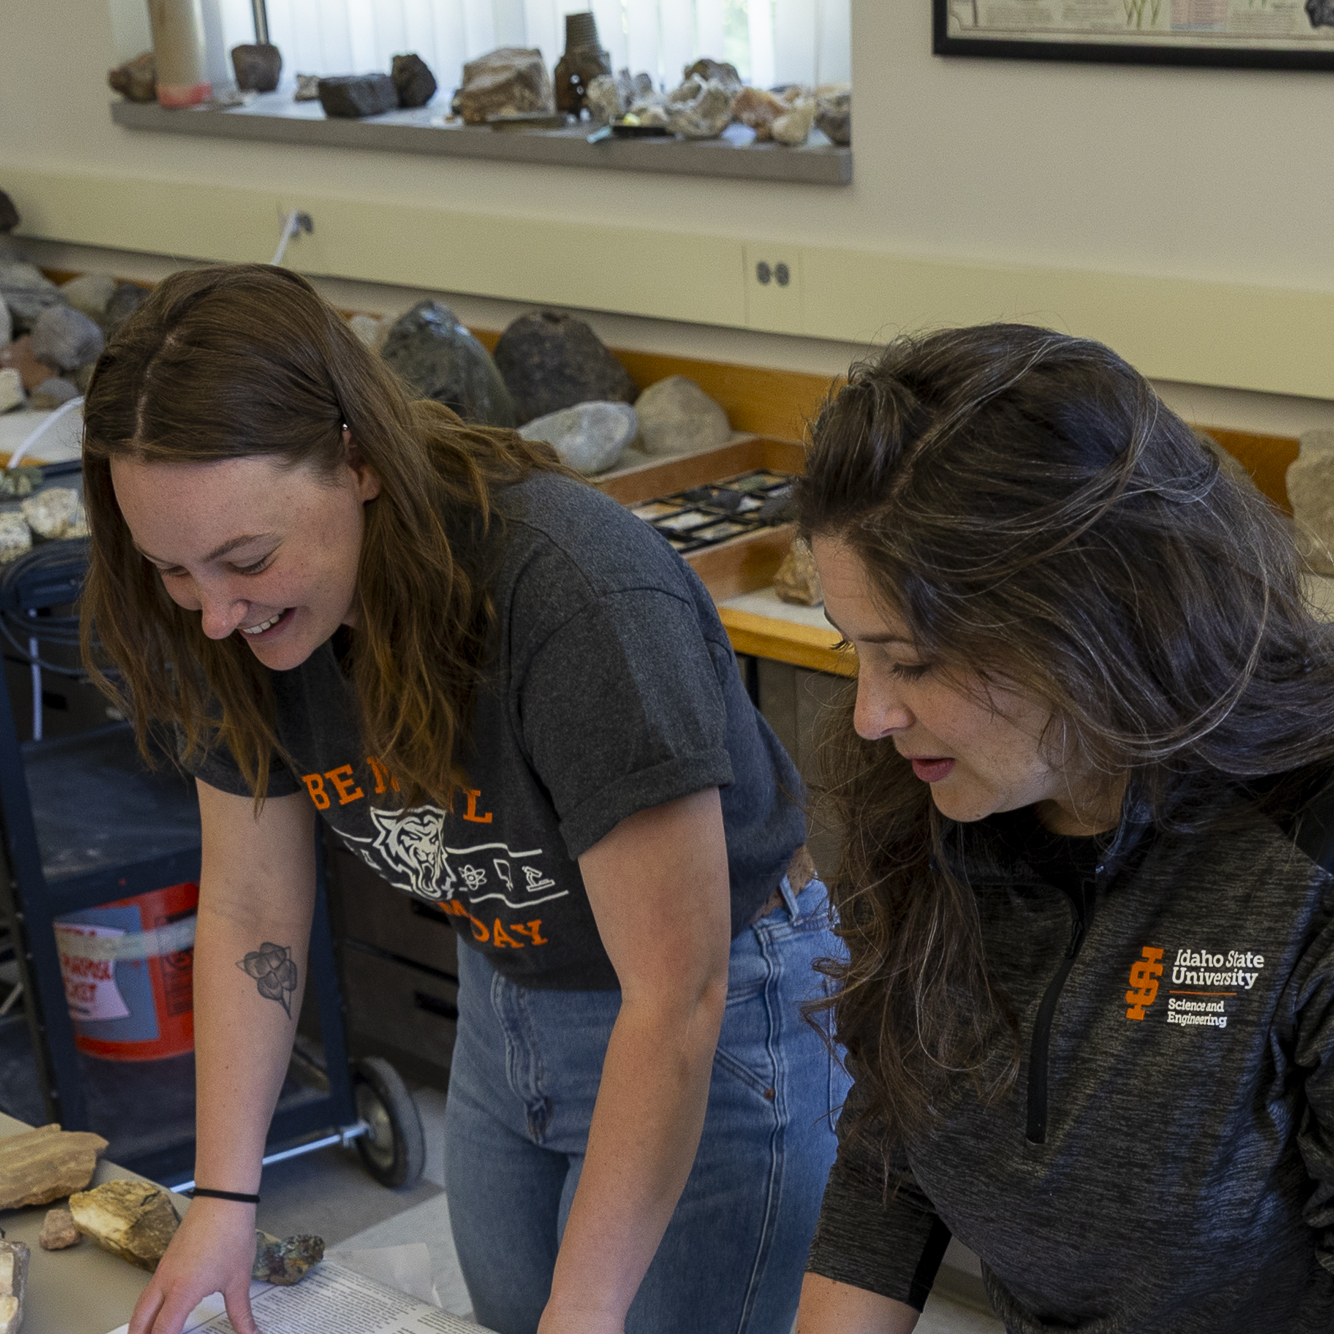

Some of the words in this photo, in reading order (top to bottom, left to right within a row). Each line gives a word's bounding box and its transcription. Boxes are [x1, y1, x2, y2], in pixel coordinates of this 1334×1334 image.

[1174, 949, 1224, 968] Idaho
[1225, 950, 1264, 968] State
[1171, 966, 1259, 989] University
[1168, 998, 1206, 1011] Science
[1206, 1001, 1224, 1012] and
[1167, 1012, 1227, 1028] Engineering
